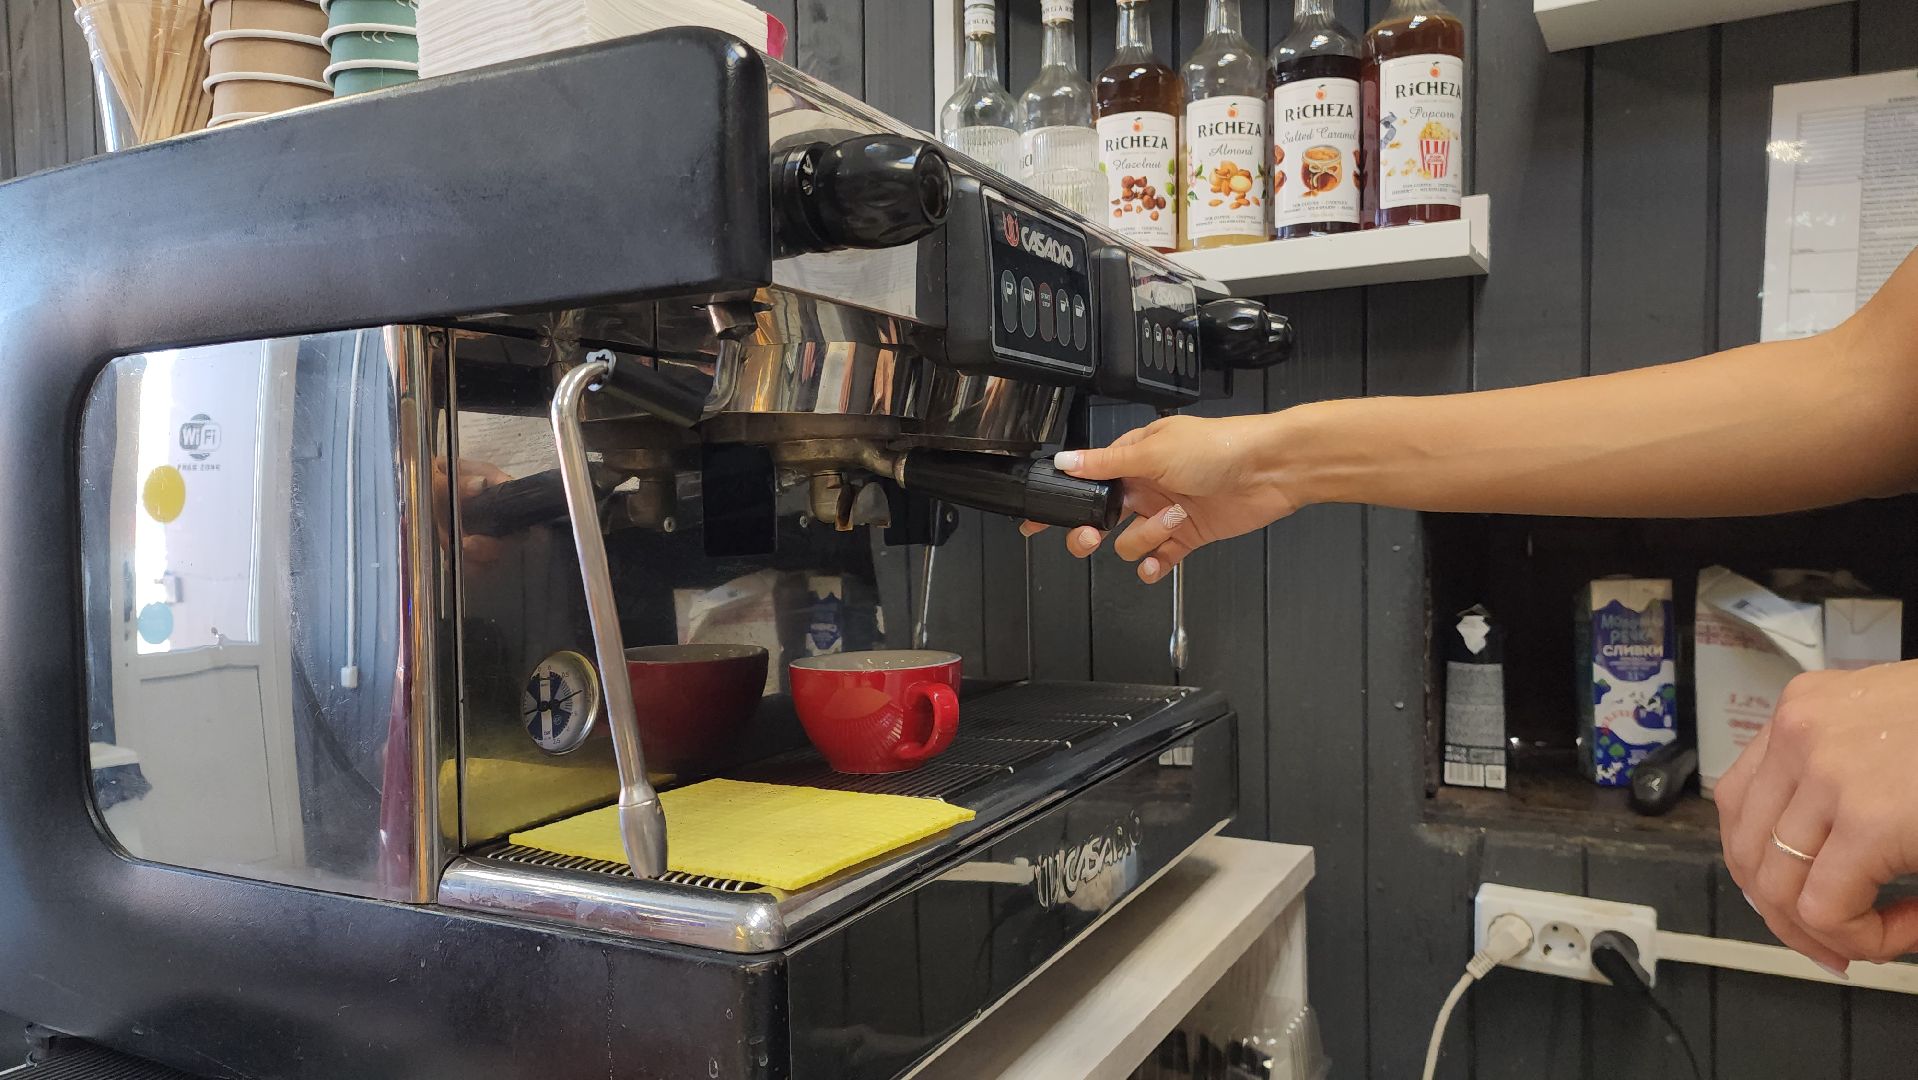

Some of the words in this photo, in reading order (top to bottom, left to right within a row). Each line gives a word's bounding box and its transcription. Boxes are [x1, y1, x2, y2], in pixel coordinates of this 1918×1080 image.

[1396, 82, 1462, 99] RiCHEZA
[1285, 103, 1354, 122] RiCHEZA
[1410, 106, 1454, 120] Popcorn
[1198, 121, 1262, 138] RiCHEZA
[1282, 128, 1313, 144] Salted
[1316, 127, 1356, 140] Caramel
[1105, 135, 1169, 152] RiCHEZA
[1209, 144, 1253, 157] Almond
[1113, 157, 1161, 170] Hazelnut
[1021, 226, 1074, 269] CASADIO
[1602, 644, 1665, 658] СЛИВКИ
